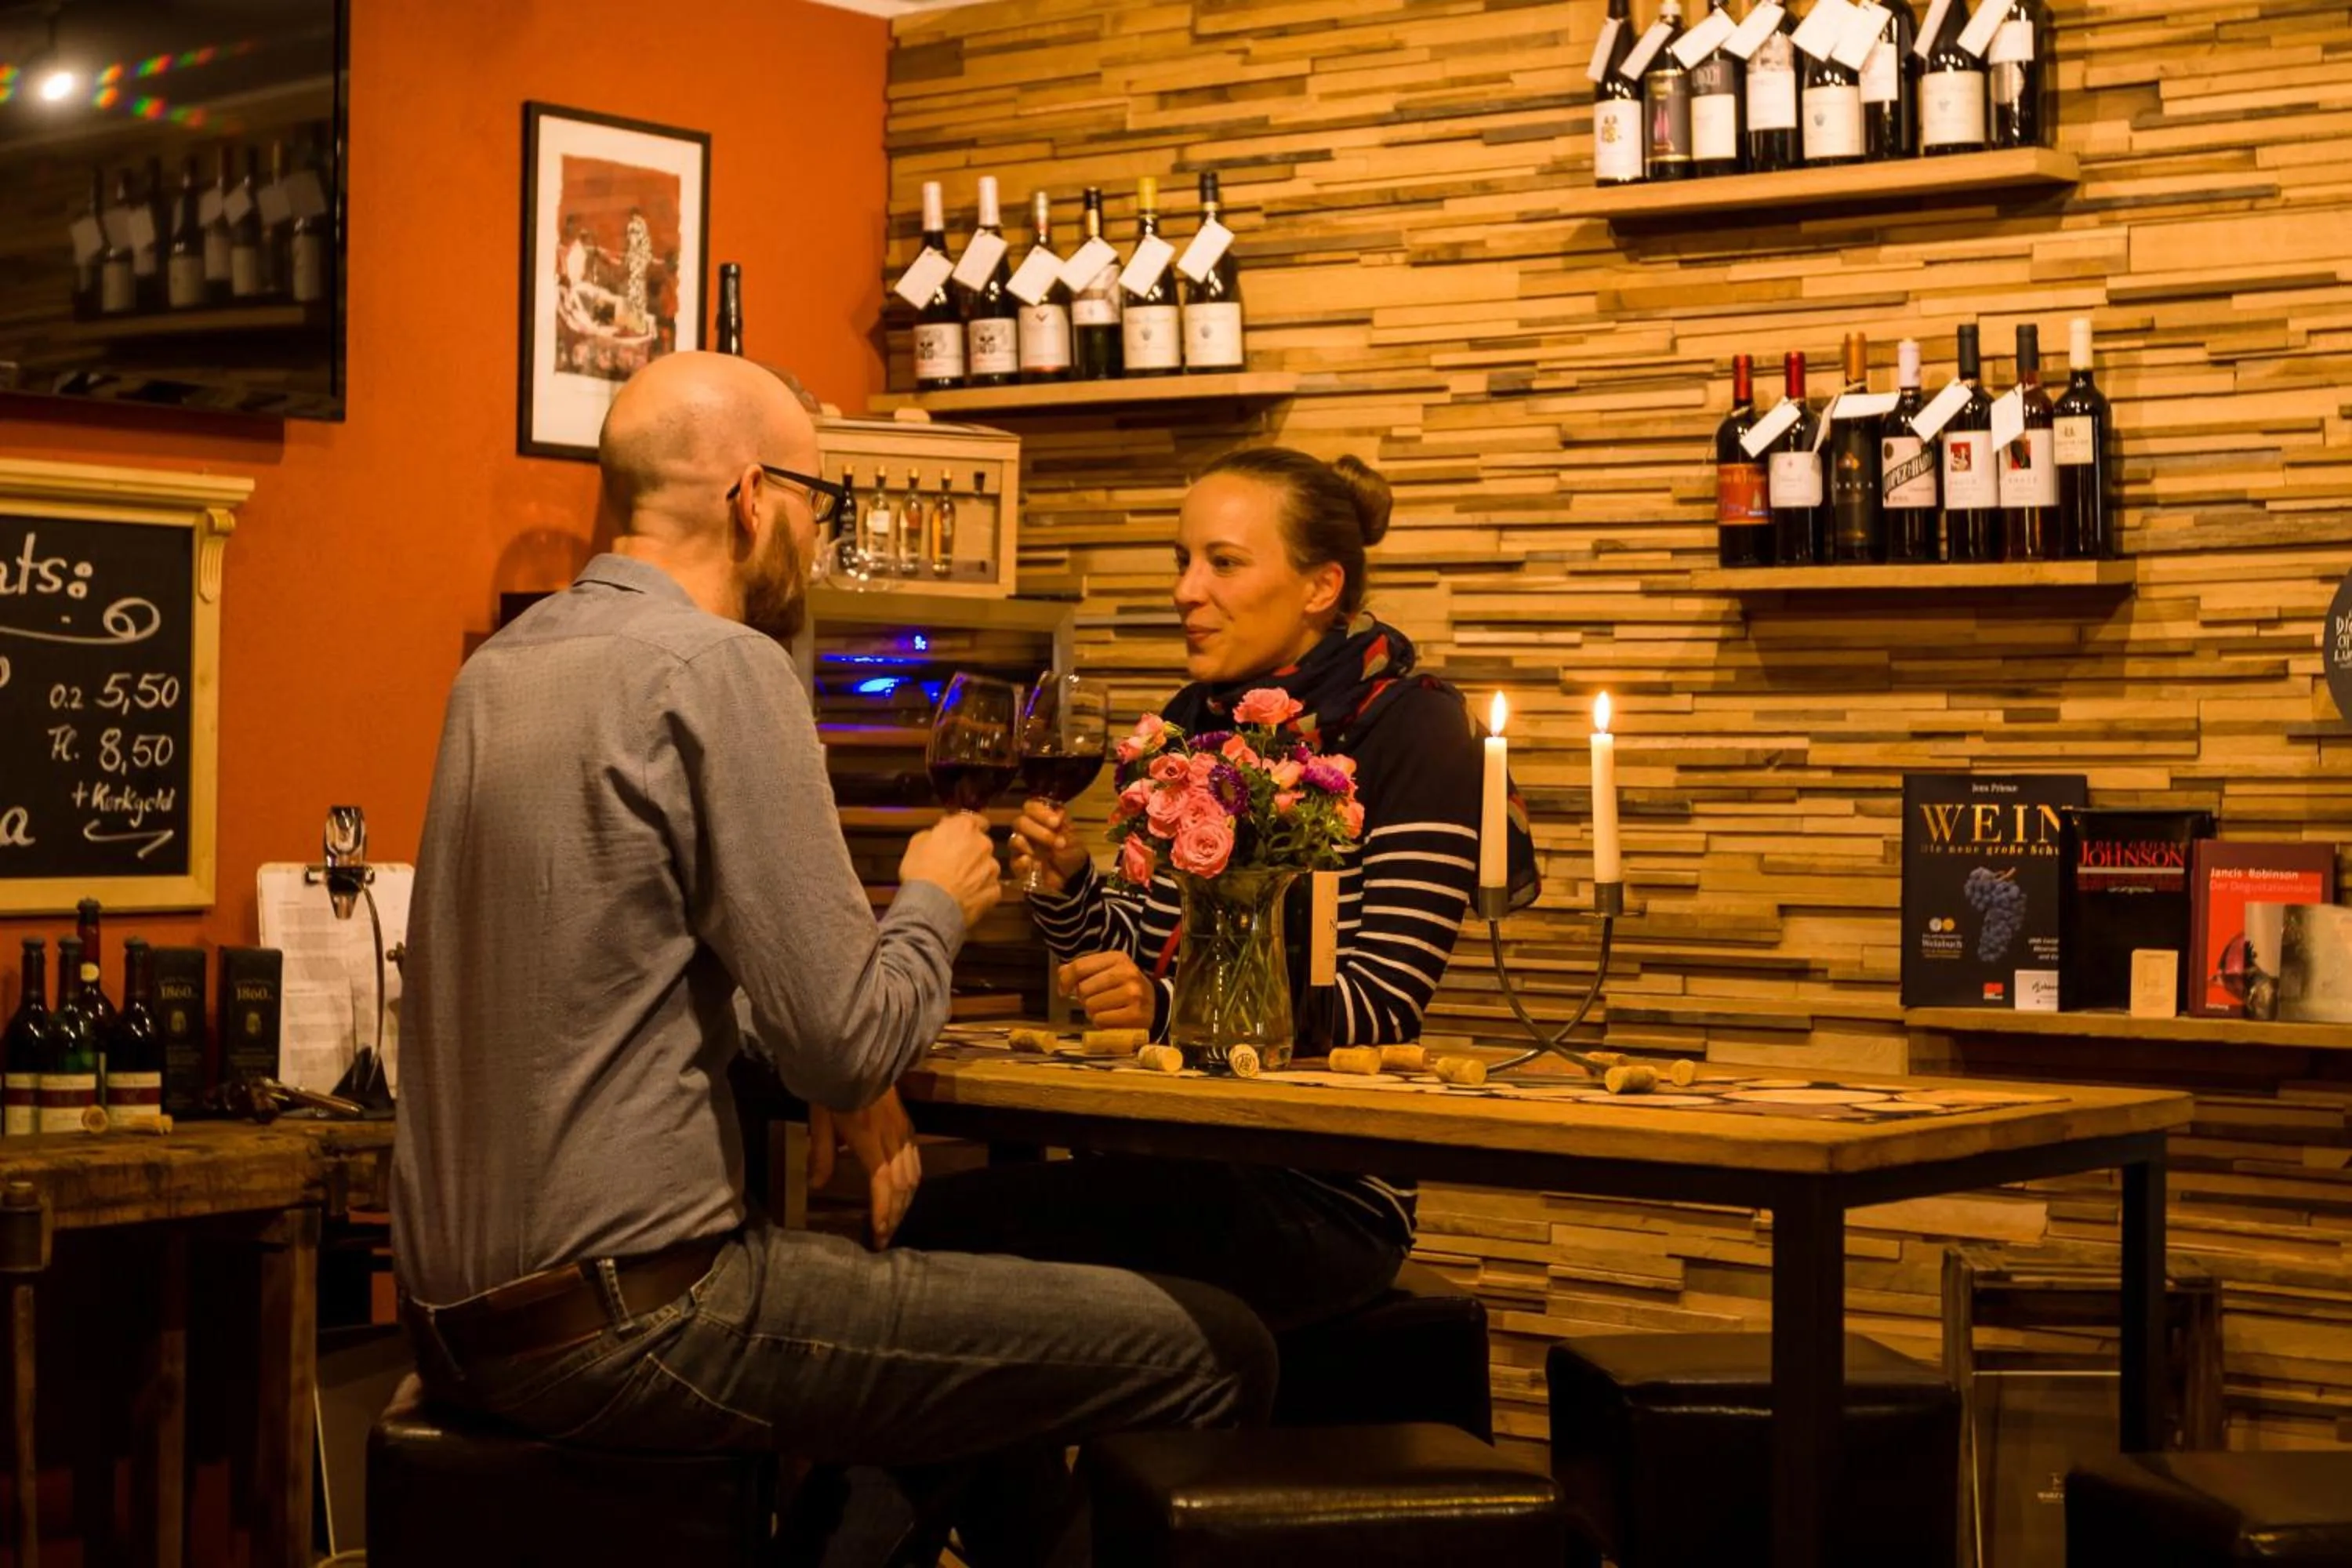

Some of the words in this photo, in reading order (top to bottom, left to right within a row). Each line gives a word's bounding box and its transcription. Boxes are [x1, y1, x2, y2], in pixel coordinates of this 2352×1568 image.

[95, 672, 180, 717] 5,50
[99, 727, 174, 776] 8,50
[2082, 840, 2184, 867] JOHNSON
